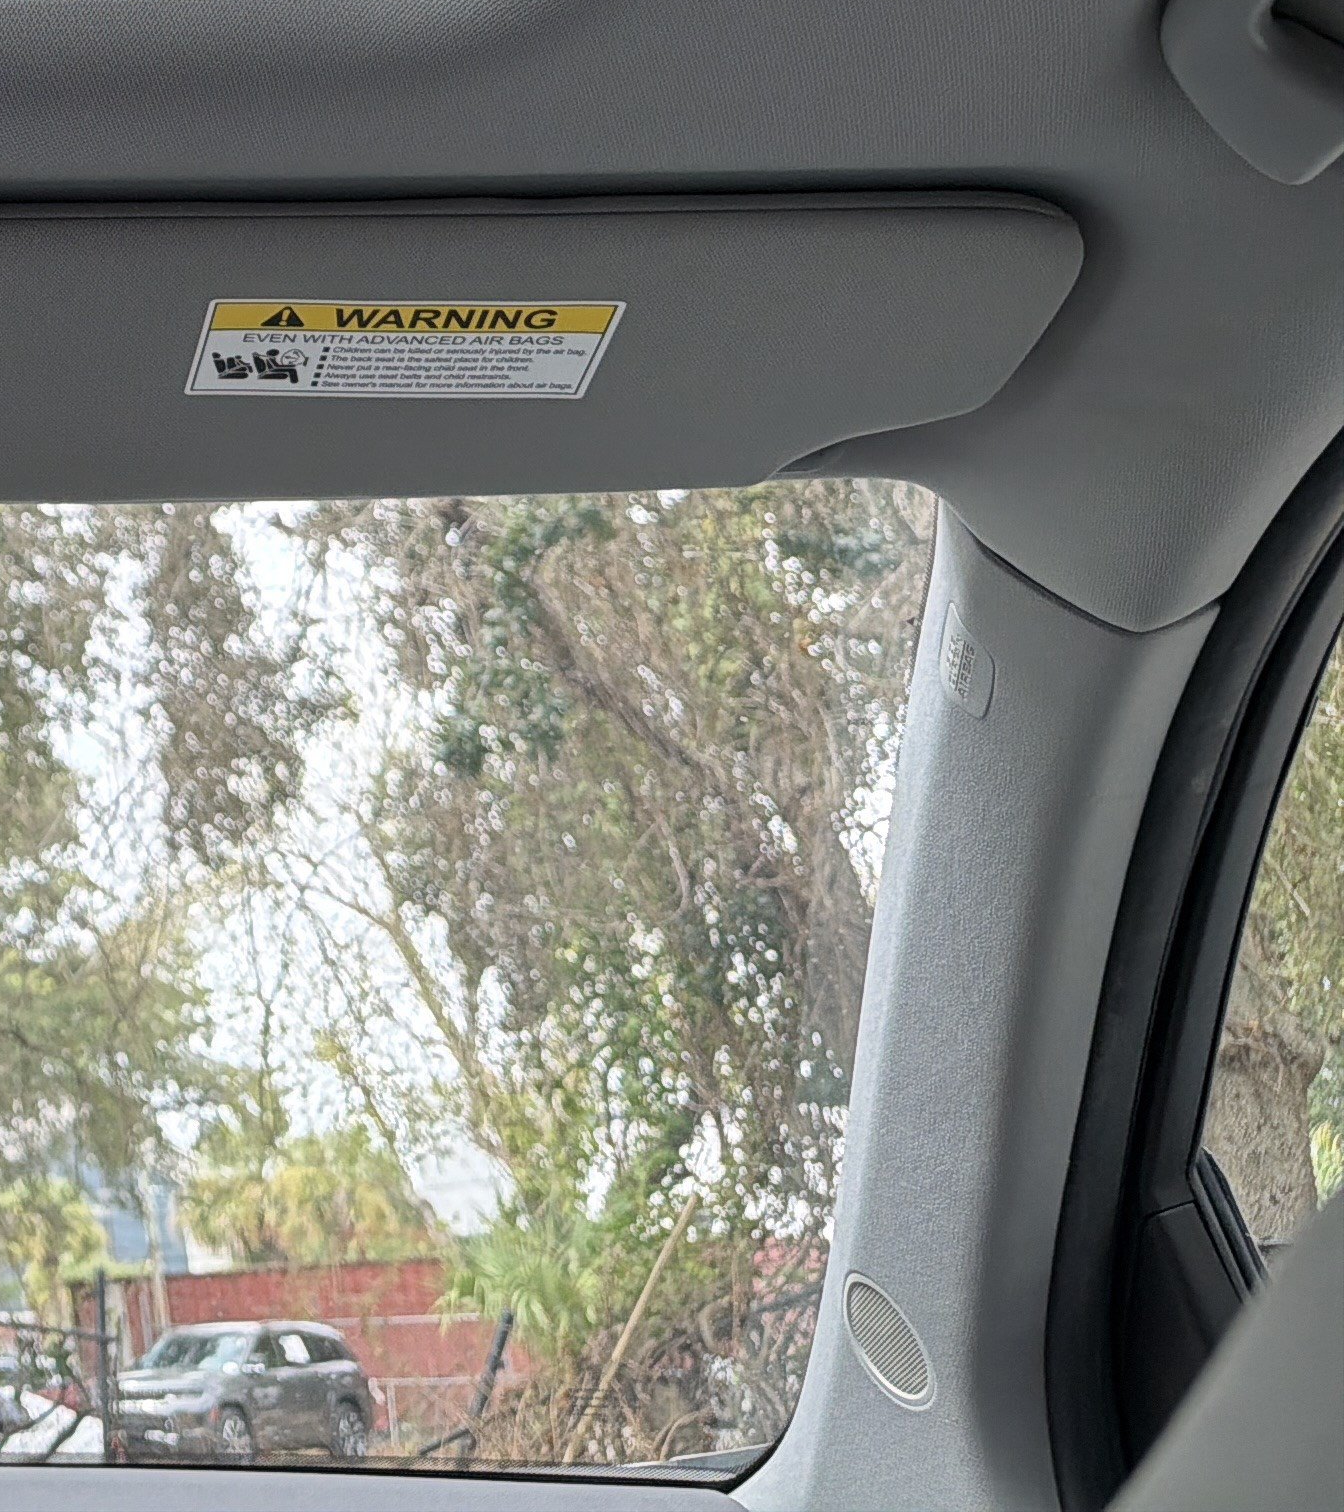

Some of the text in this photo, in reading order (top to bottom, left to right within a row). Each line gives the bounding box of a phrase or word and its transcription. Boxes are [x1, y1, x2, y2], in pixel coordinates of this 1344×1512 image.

[335, 308, 558, 329] WARNING
[242, 333, 564, 346] EVEN WITH ADVANCED AIR BAGS
